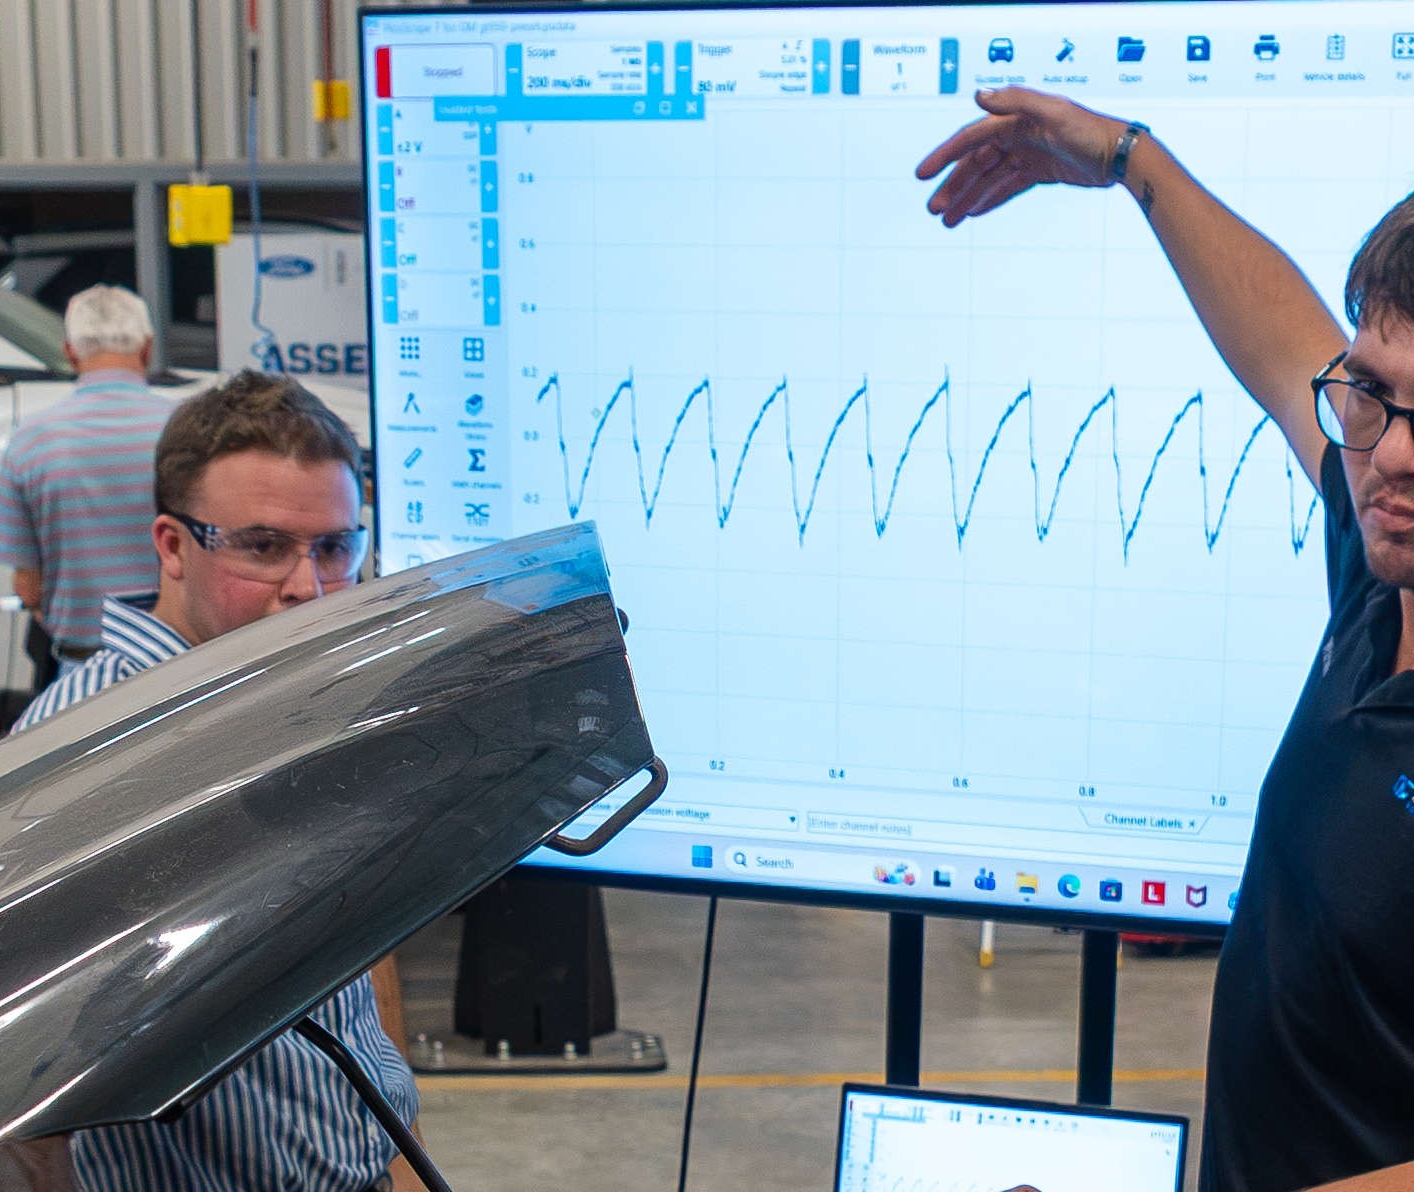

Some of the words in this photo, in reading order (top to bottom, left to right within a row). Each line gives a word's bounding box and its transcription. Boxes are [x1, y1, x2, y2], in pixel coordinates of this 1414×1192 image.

[1104, 813, 1149, 828] Channel
[1150, 817, 1184, 830] Labels
[755, 855, 794, 871] Search
